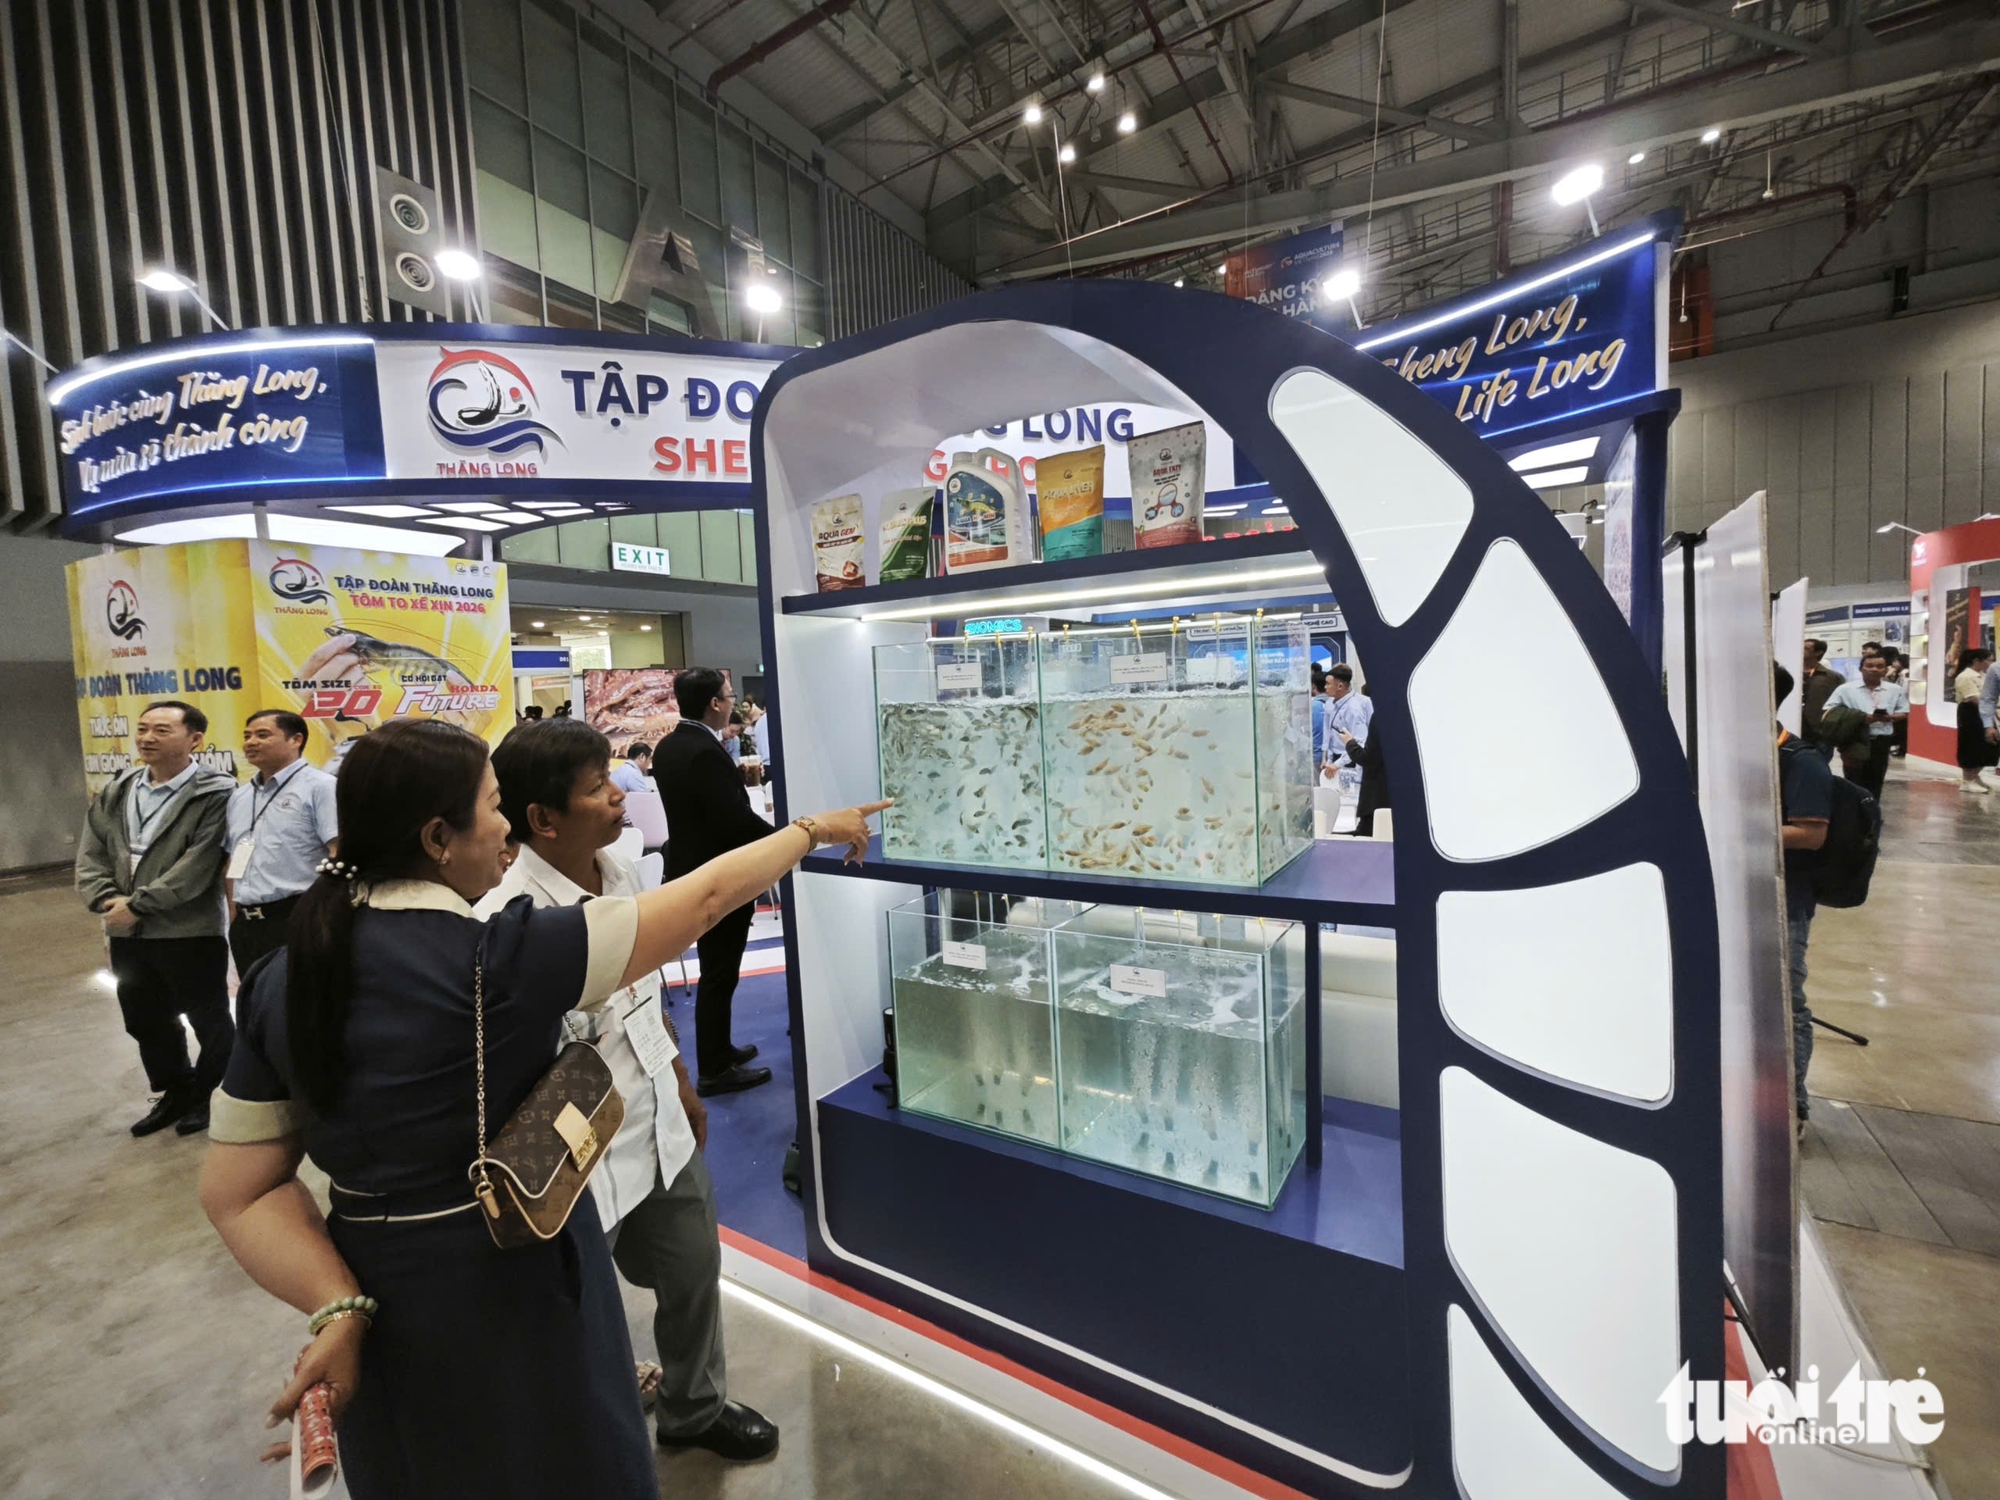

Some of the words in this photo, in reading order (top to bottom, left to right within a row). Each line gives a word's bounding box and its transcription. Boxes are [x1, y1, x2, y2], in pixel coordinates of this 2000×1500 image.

[1485, 294, 1587, 356] Long,
[177, 371, 250, 409] Thăng
[252, 363, 327, 401] Long,
[560, 360, 670, 428] TẬP
[684, 376, 761, 420] ĐO
[1455, 368, 1518, 424] Life
[1527, 338, 1626, 400] Long
[163, 412, 237, 462] thành
[239, 413, 309, 453] công
[1022, 408, 1134, 443] LONG
[436, 460, 491, 475] THĂNG
[496, 462, 538, 475] LONG
[653, 436, 749, 475] SHE
[818, 530, 840, 541] AQUA
[618, 547, 665, 566] EXIT
[334, 575, 365, 592] TẬP
[369, 576, 410, 593] ĐOÀN
[413, 580, 458, 596] THĂNG
[461, 586, 494, 599] LONG
[275, 606, 304, 615] THĂNG
[351, 593, 385, 608] TÔM
[387, 596, 408, 610] TO
[455, 601, 487, 614] 2026
[89, 670, 122, 698] ĐOÀN
[125, 667, 178, 695] THĂNG
[184, 667, 243, 692] LONG
[282, 677, 317, 689] TÔM
[320, 679, 352, 689] SIZE
[450, 685, 498, 694] HONDA
[301, 689, 383, 719] 20
